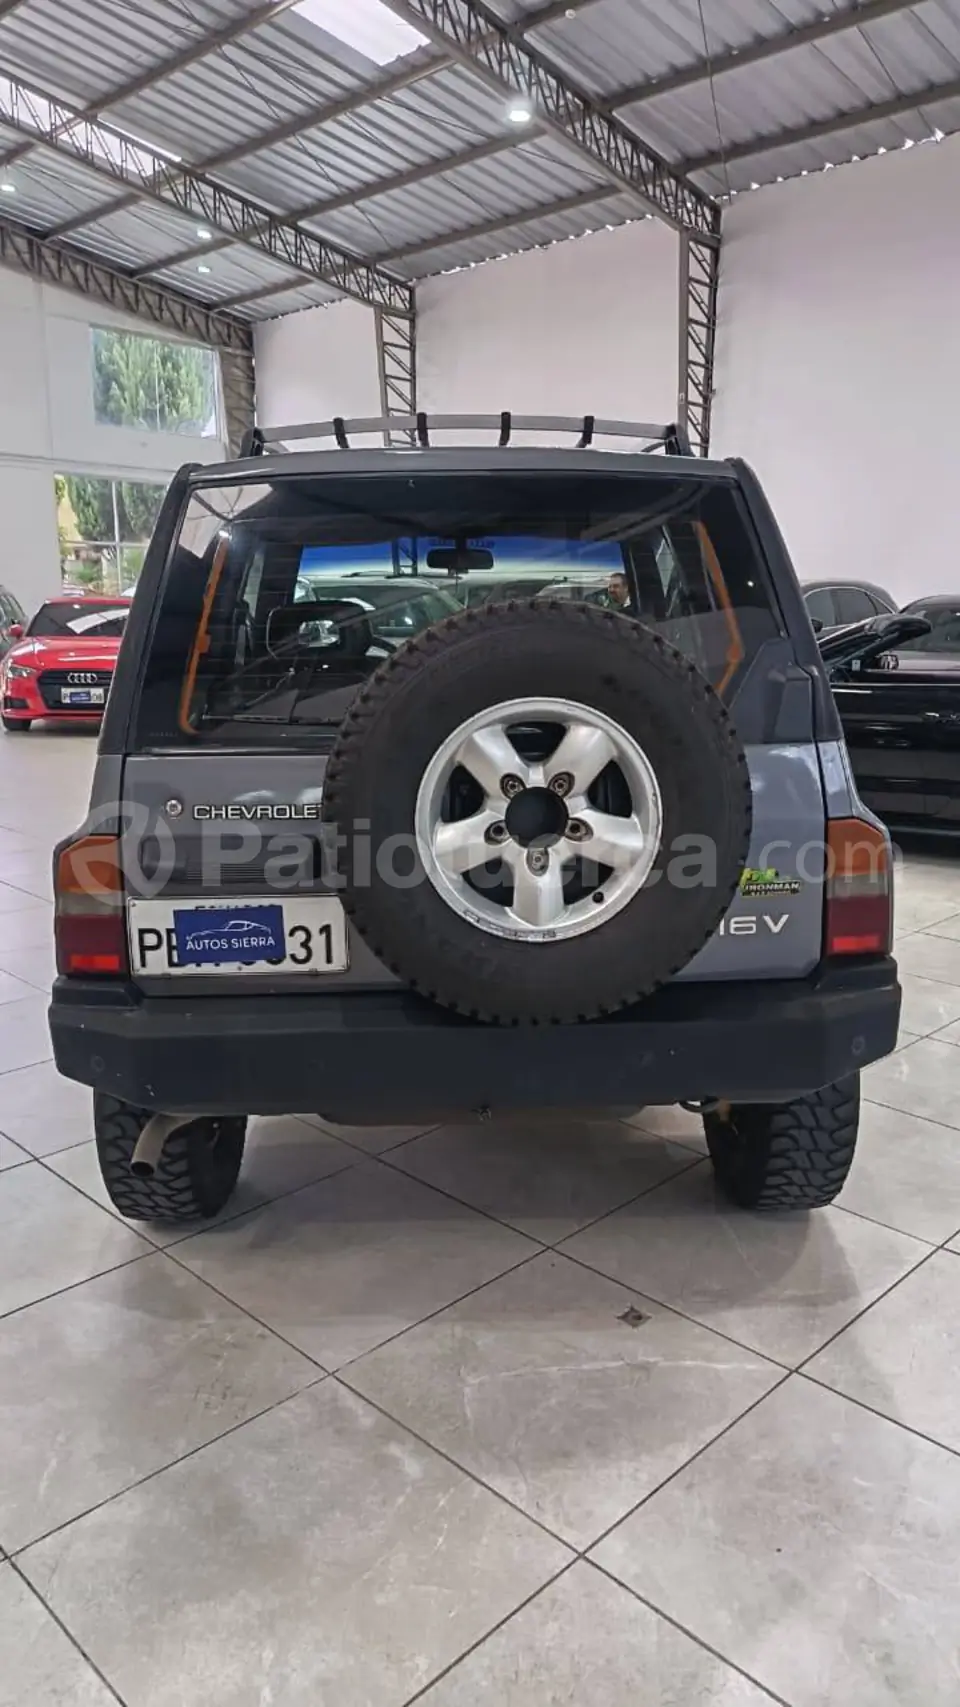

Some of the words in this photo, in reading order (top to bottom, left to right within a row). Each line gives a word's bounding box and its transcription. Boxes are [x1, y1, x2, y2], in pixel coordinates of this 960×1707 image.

[193, 804, 323, 820] CHEVROLE
[186, 938, 229, 951] AUTOS
[231, 935, 276, 949] SIERRA
